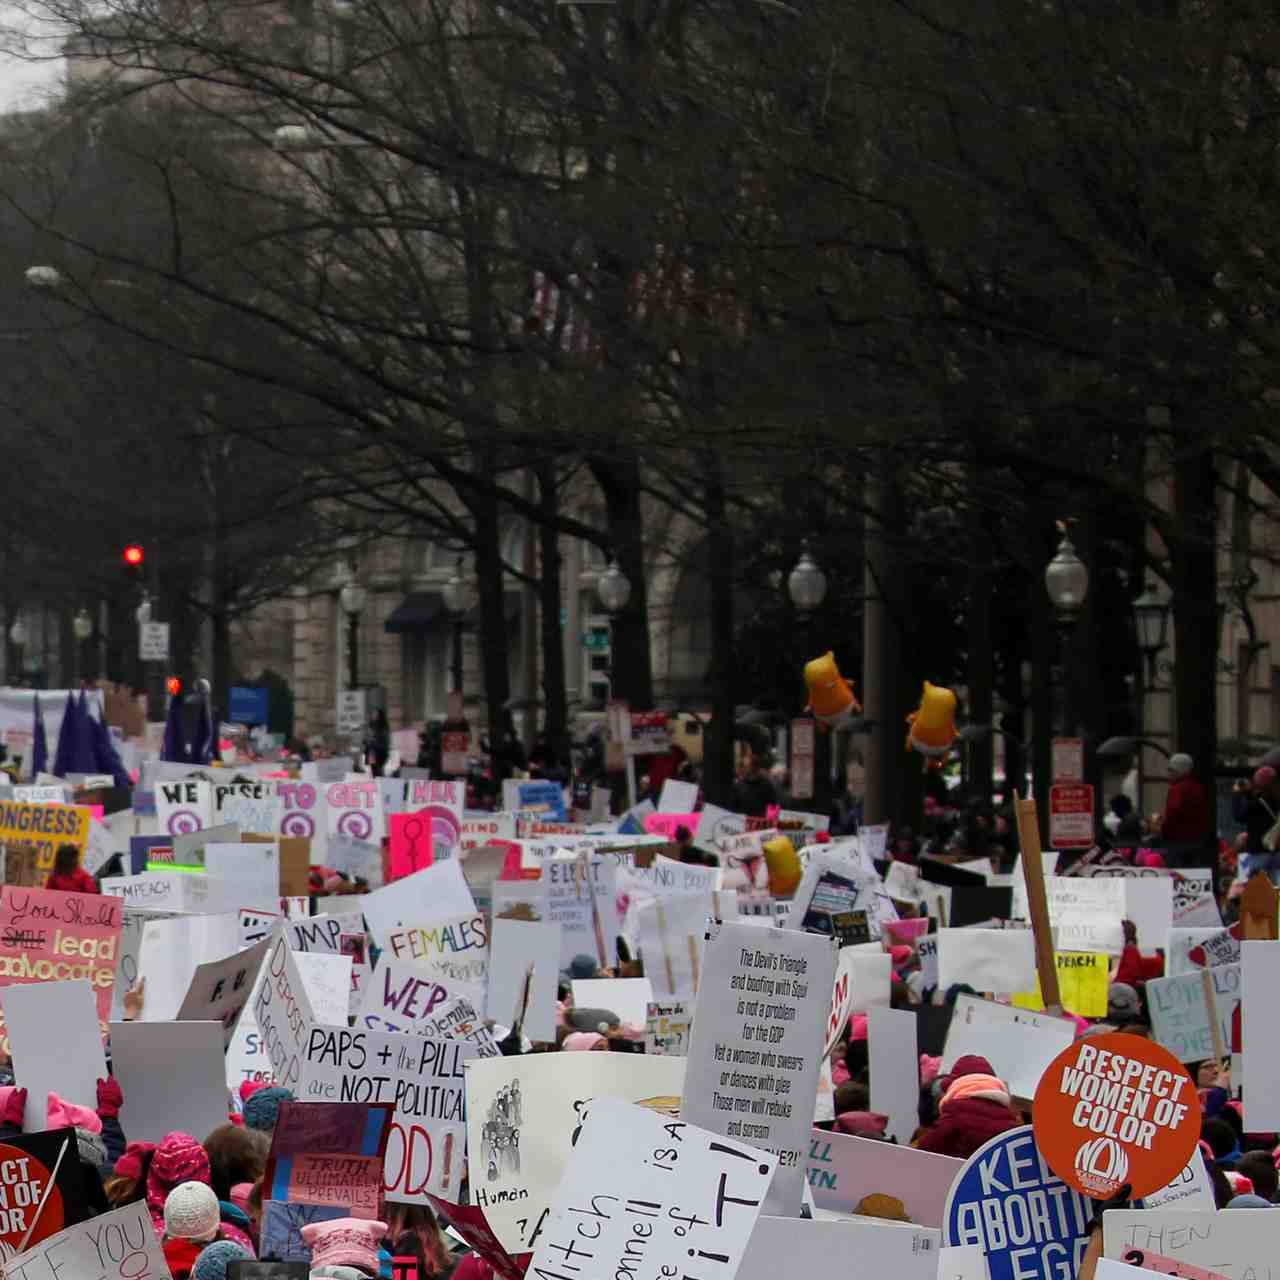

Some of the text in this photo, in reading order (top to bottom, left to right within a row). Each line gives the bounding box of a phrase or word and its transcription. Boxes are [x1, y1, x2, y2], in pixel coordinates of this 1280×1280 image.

[162, 783, 198, 805] WE
[278, 783, 318, 810] TO
[109, 881, 171, 898] IMPEACH
[52, 929, 116, 960] lead
[390, 917, 487, 960] FEMALES
[765, 1003, 796, 1022] problem
[307, 1028, 415, 1071] PAPS the
[1075, 1043, 1187, 1102] RESPECT
[308, 1074, 391, 1103] are NOT
[1059, 1066, 1188, 1130] WOMEN OF
[664, 1122, 687, 1142] A
[1072, 1100, 1158, 1150] COLOR
[308, 1156, 370, 1172] TRUTH
[1075, 1137, 1129, 1183] NOW
[296, 1172, 383, 1187] ULTIMATELY
[475, 1187, 528, 1207] Human
[86, 1215, 145, 1269] YOU
